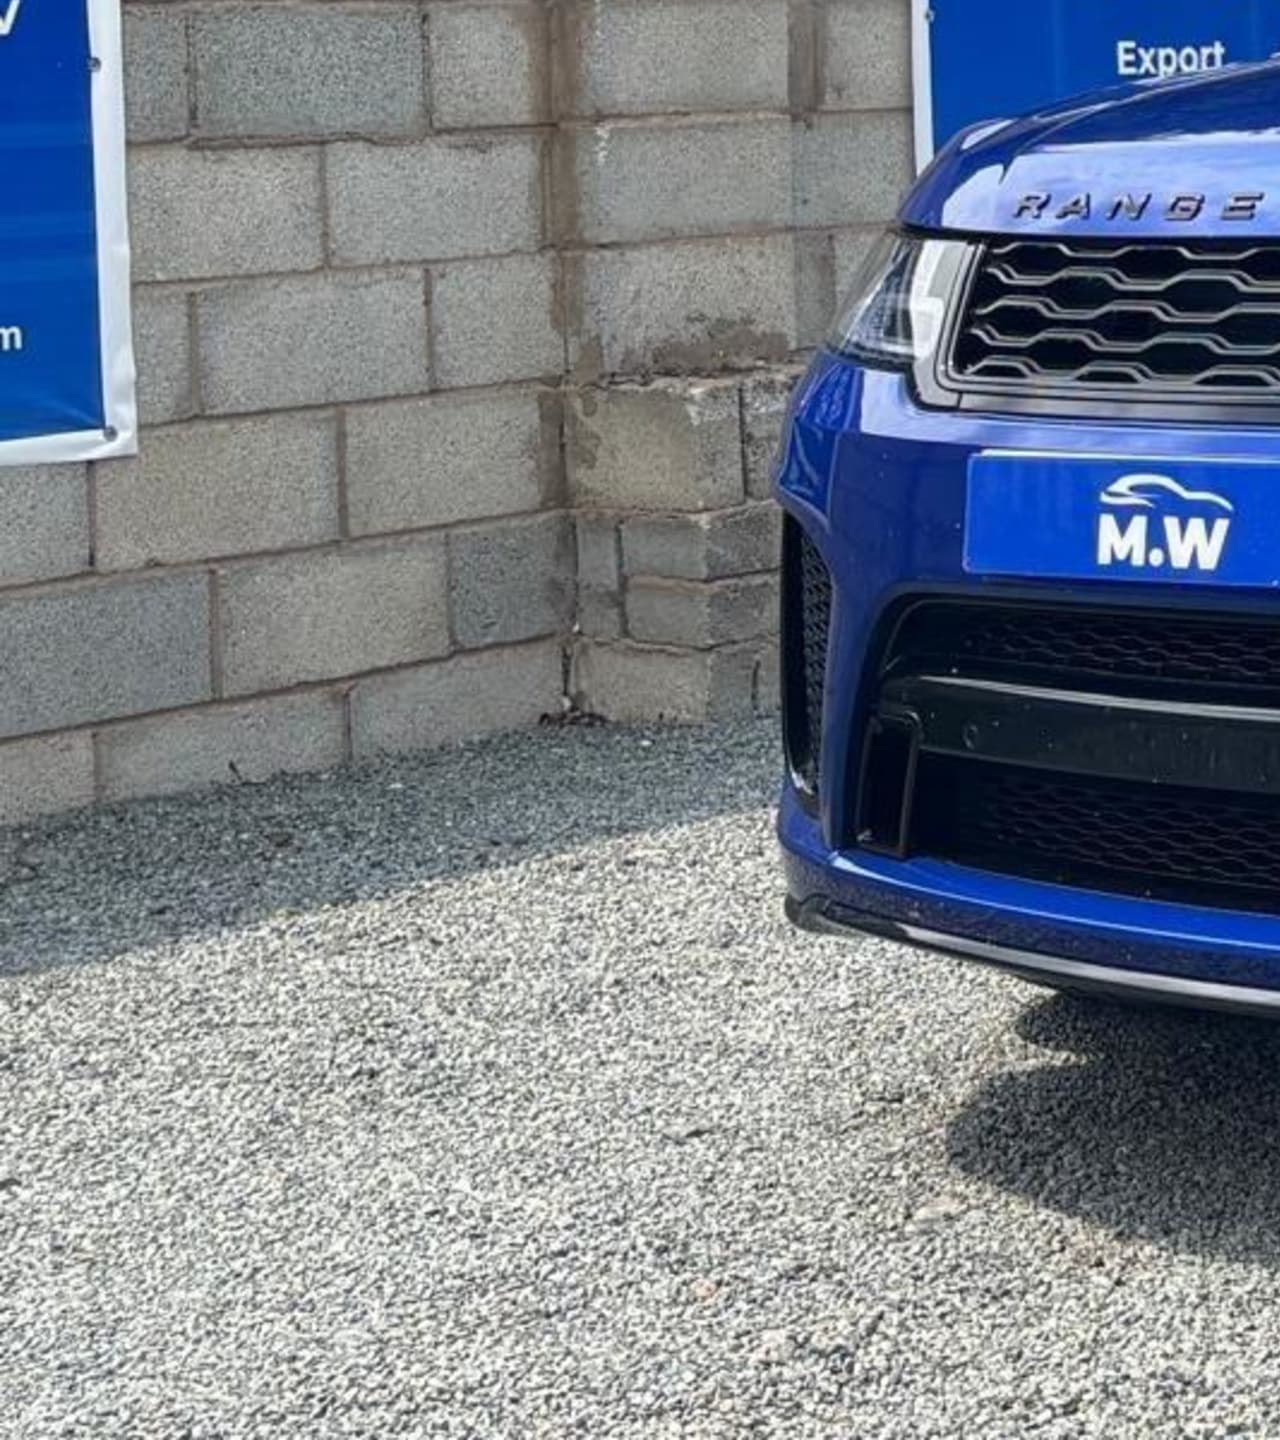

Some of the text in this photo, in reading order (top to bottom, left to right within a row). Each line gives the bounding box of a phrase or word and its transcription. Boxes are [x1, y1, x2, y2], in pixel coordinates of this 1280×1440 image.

[1116, 40, 1226, 78] Export
[1013, 191, 1263, 221] RANGE
[1096, 512, 1231, 571] M.W
